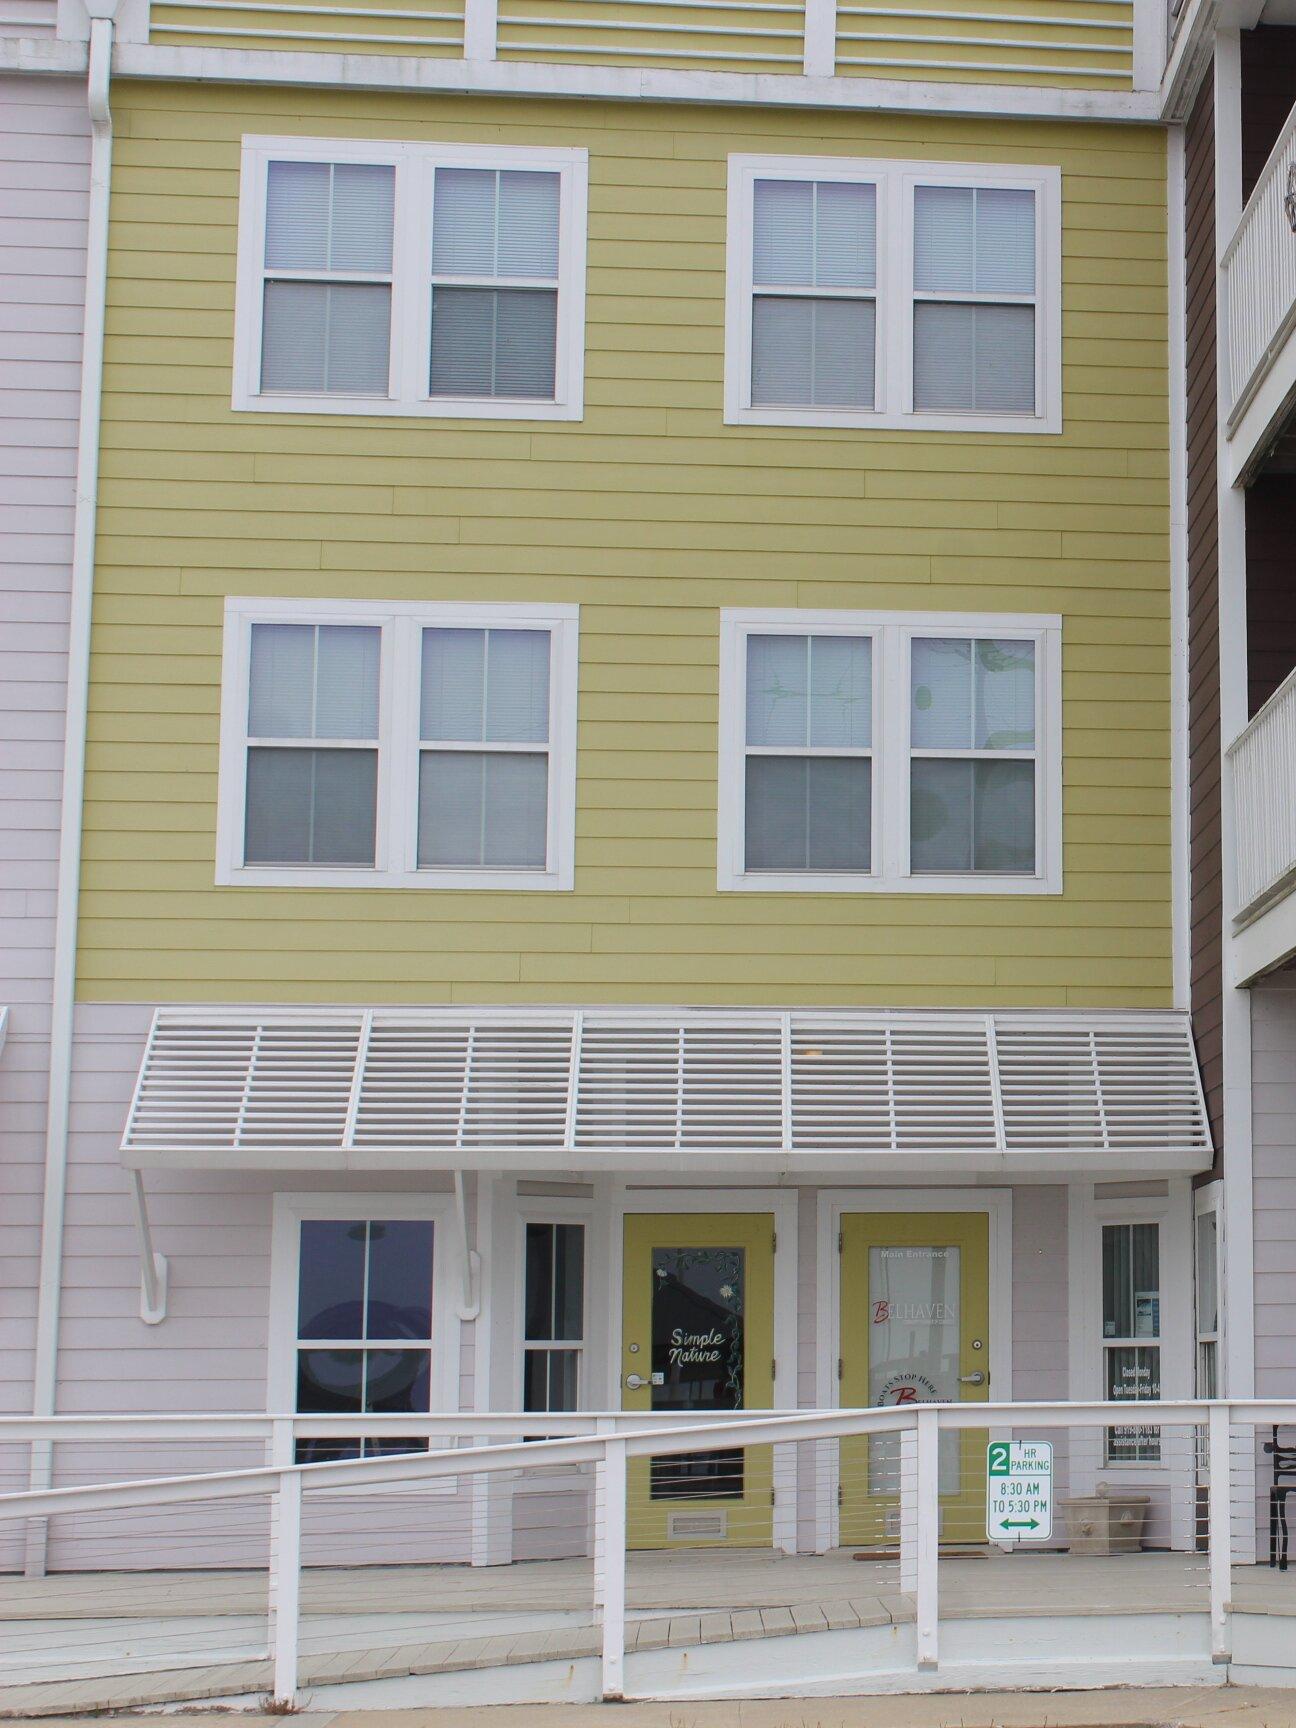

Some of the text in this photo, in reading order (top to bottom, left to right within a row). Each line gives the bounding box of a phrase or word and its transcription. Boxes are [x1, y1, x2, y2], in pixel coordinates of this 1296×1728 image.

[881, 1250, 950, 1258] Main Entrance
[872, 1300, 955, 1324] BELHAVEN
[671, 1327, 726, 1349] Simple
[668, 1346, 722, 1368] Nature
[991, 1447, 1037, 1471] 2 HR
[1011, 1460, 1050, 1471] PARKING
[1000, 1482, 1040, 1496] 8:30 AM
[993, 1500, 1048, 1513] TO 5:30 PM
